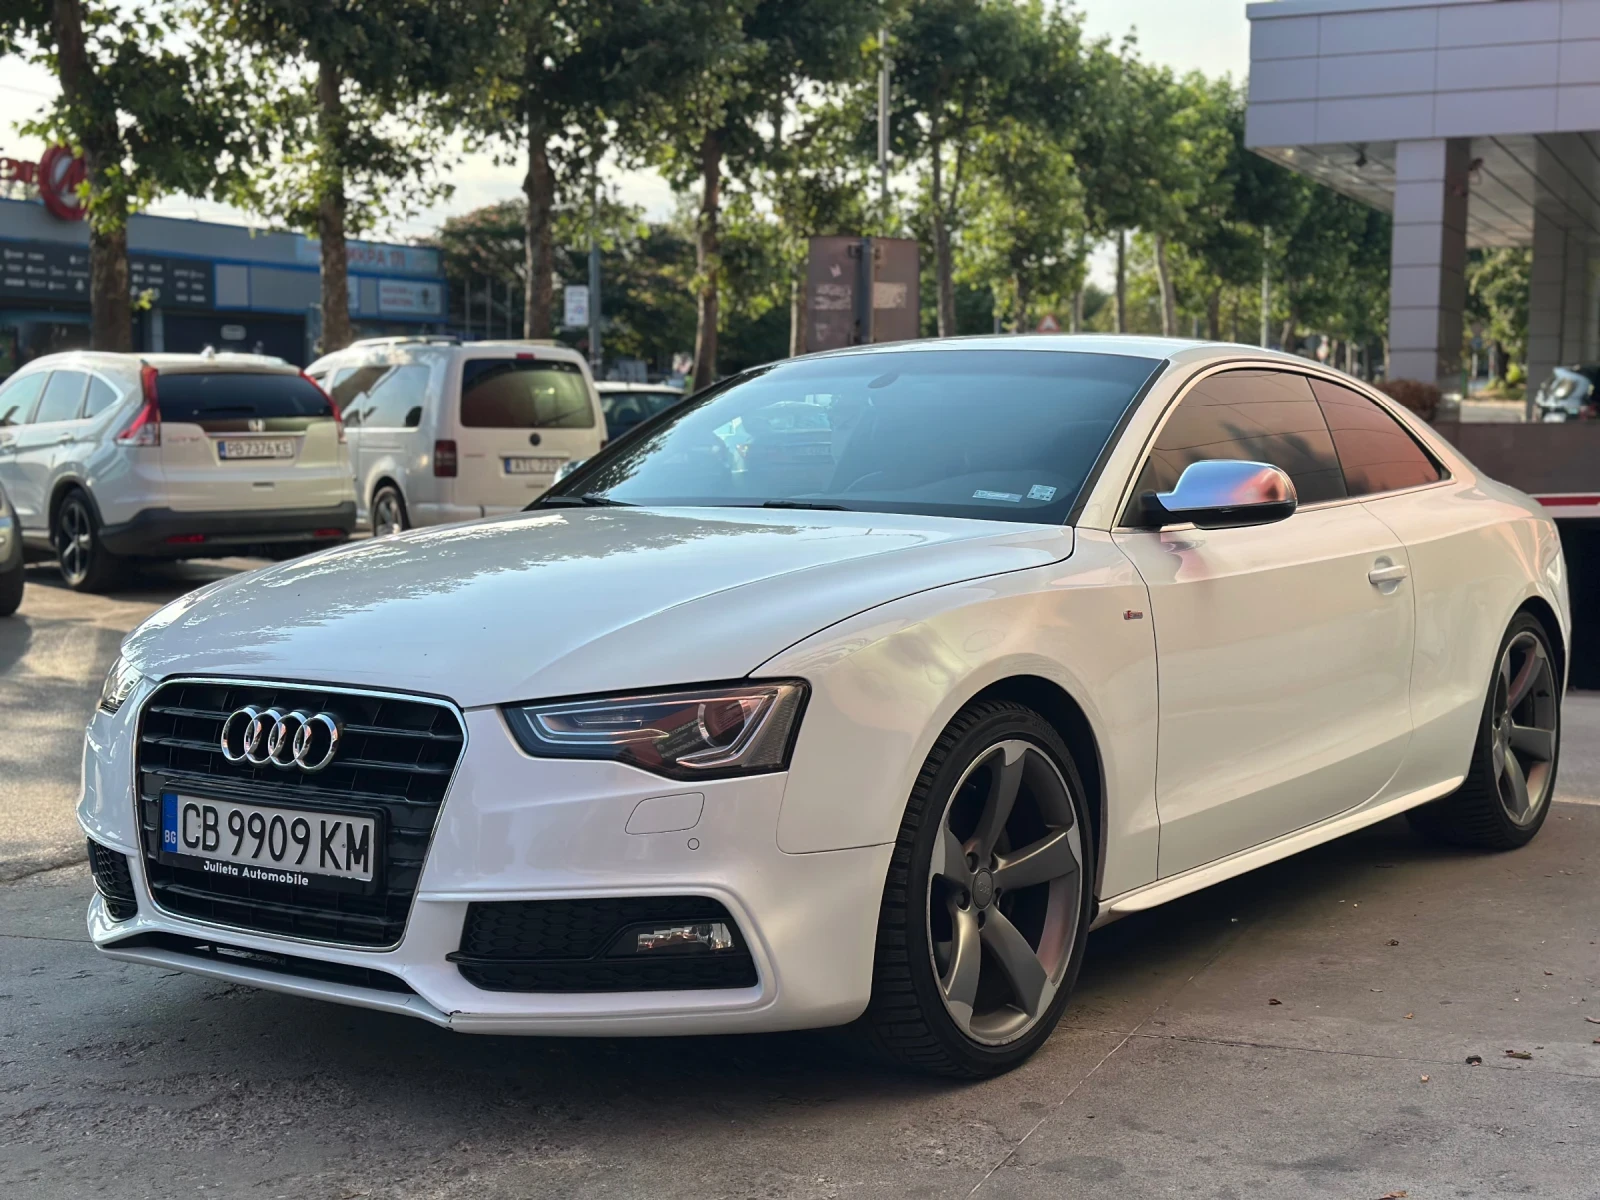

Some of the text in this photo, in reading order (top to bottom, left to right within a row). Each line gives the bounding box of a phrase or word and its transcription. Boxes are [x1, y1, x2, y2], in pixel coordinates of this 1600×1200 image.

[164, 829, 177, 844] BG
[183, 802, 370, 873] CB 9909 KM
[203, 860, 309, 886] Julieta Automobile
